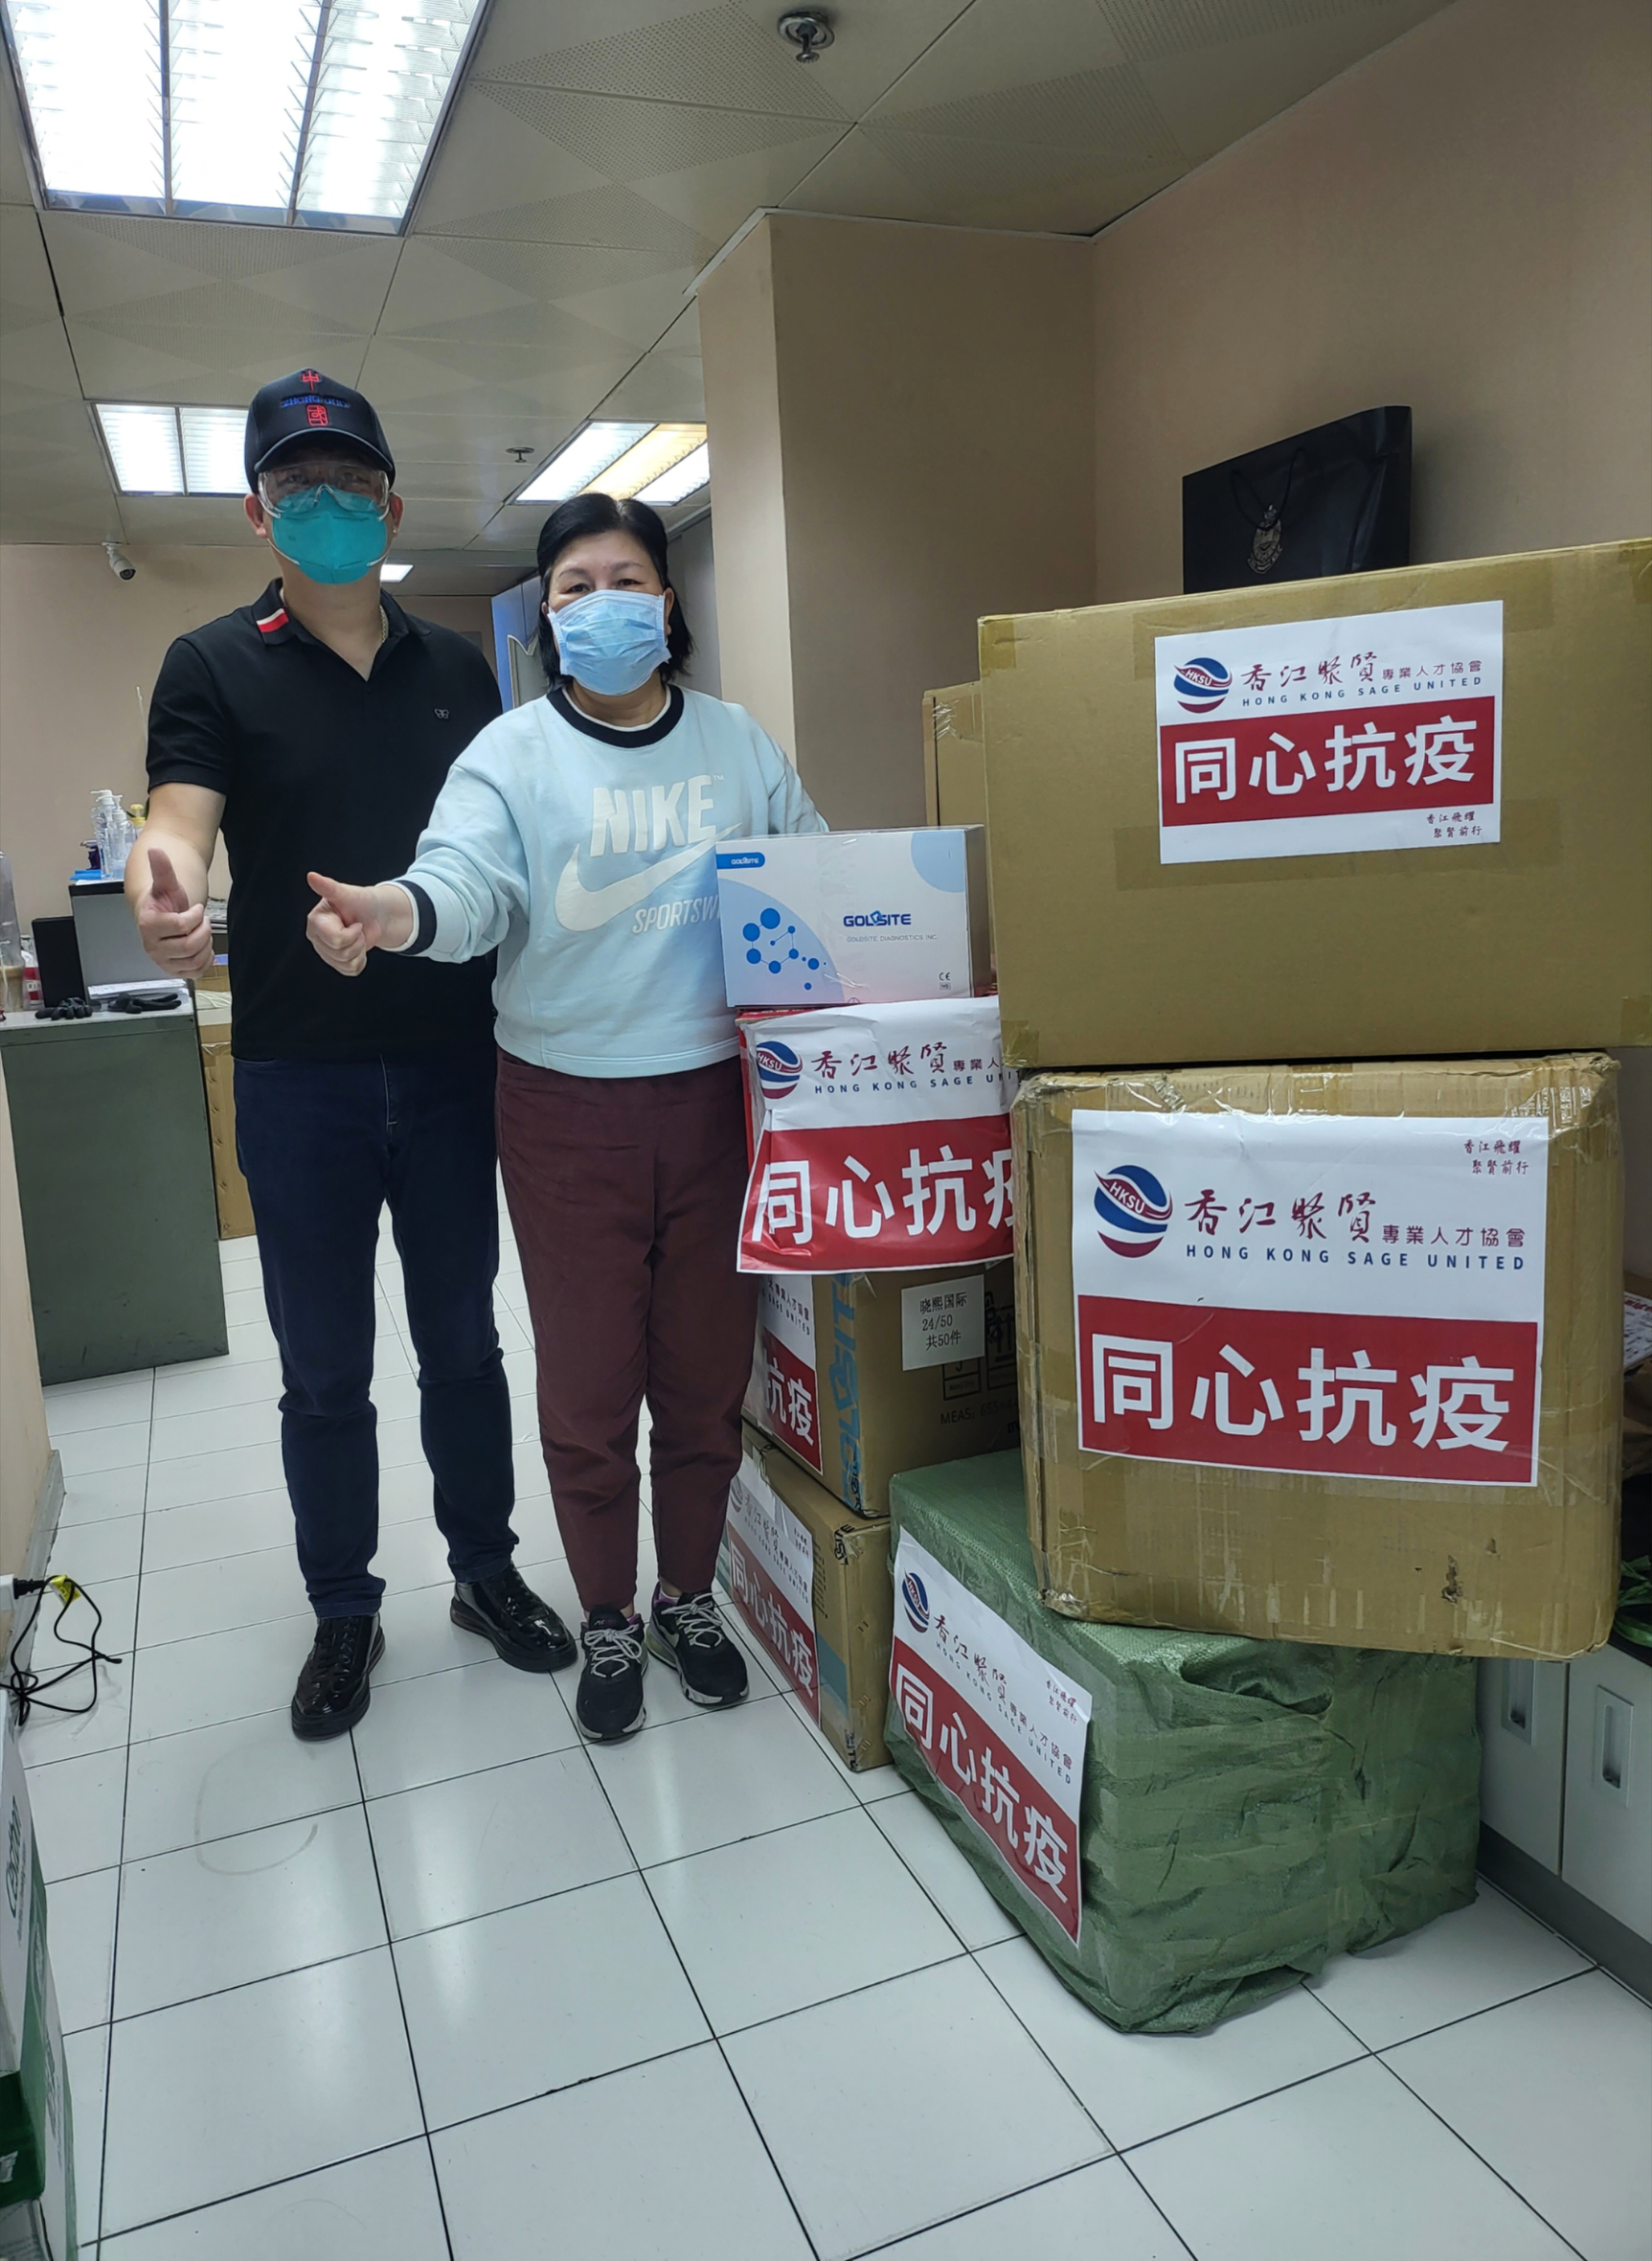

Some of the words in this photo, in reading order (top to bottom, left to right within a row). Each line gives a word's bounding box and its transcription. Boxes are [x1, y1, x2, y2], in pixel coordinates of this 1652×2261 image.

[282, 395, 320, 408] ZHONG
[1185, 669, 1213, 687] HKSU
[1382, 660, 1482, 680] 專業人才協會
[1242, 694, 1288, 707] HONG
[1300, 690, 1345, 703] KONG
[1357, 684, 1401, 696] SAGE
[1414, 676, 1482, 691] UNITED
[1174, 715, 1478, 804] 同心抗疫
[590, 774, 717, 857] NIKE
[632, 895, 721, 934] SPORTSW
[815, 1083, 861, 1095] HONG
[873, 1080, 918, 1092] KONG
[931, 1076, 973, 1088] SAGE
[1109, 1180, 1146, 1215] HKSU
[1382, 1224, 1526, 1248] 專業人才協會
[1186, 1244, 1250, 1261] HONG
[1266, 1246, 1330, 1263] KONG
[1347, 1251, 1409, 1267] SAGE
[1427, 1254, 1526, 1271] UNITED
[786, 1309, 810, 1336] UNITED
[921, 1314, 954, 1332] 24/50
[926, 1329, 962, 1351] 共50件
[1091, 1333, 1516, 1452] 同心抗疫
[731, 1538, 814, 1698] 同心抗疫
[936, 1642, 962, 1670] HONG
[966, 1670, 993, 1702] KONG
[998, 1703, 1022, 1735] SAGE
[1028, 1735, 1071, 1784] UNITED
[897, 1663, 1069, 1904] 同心抗疫
